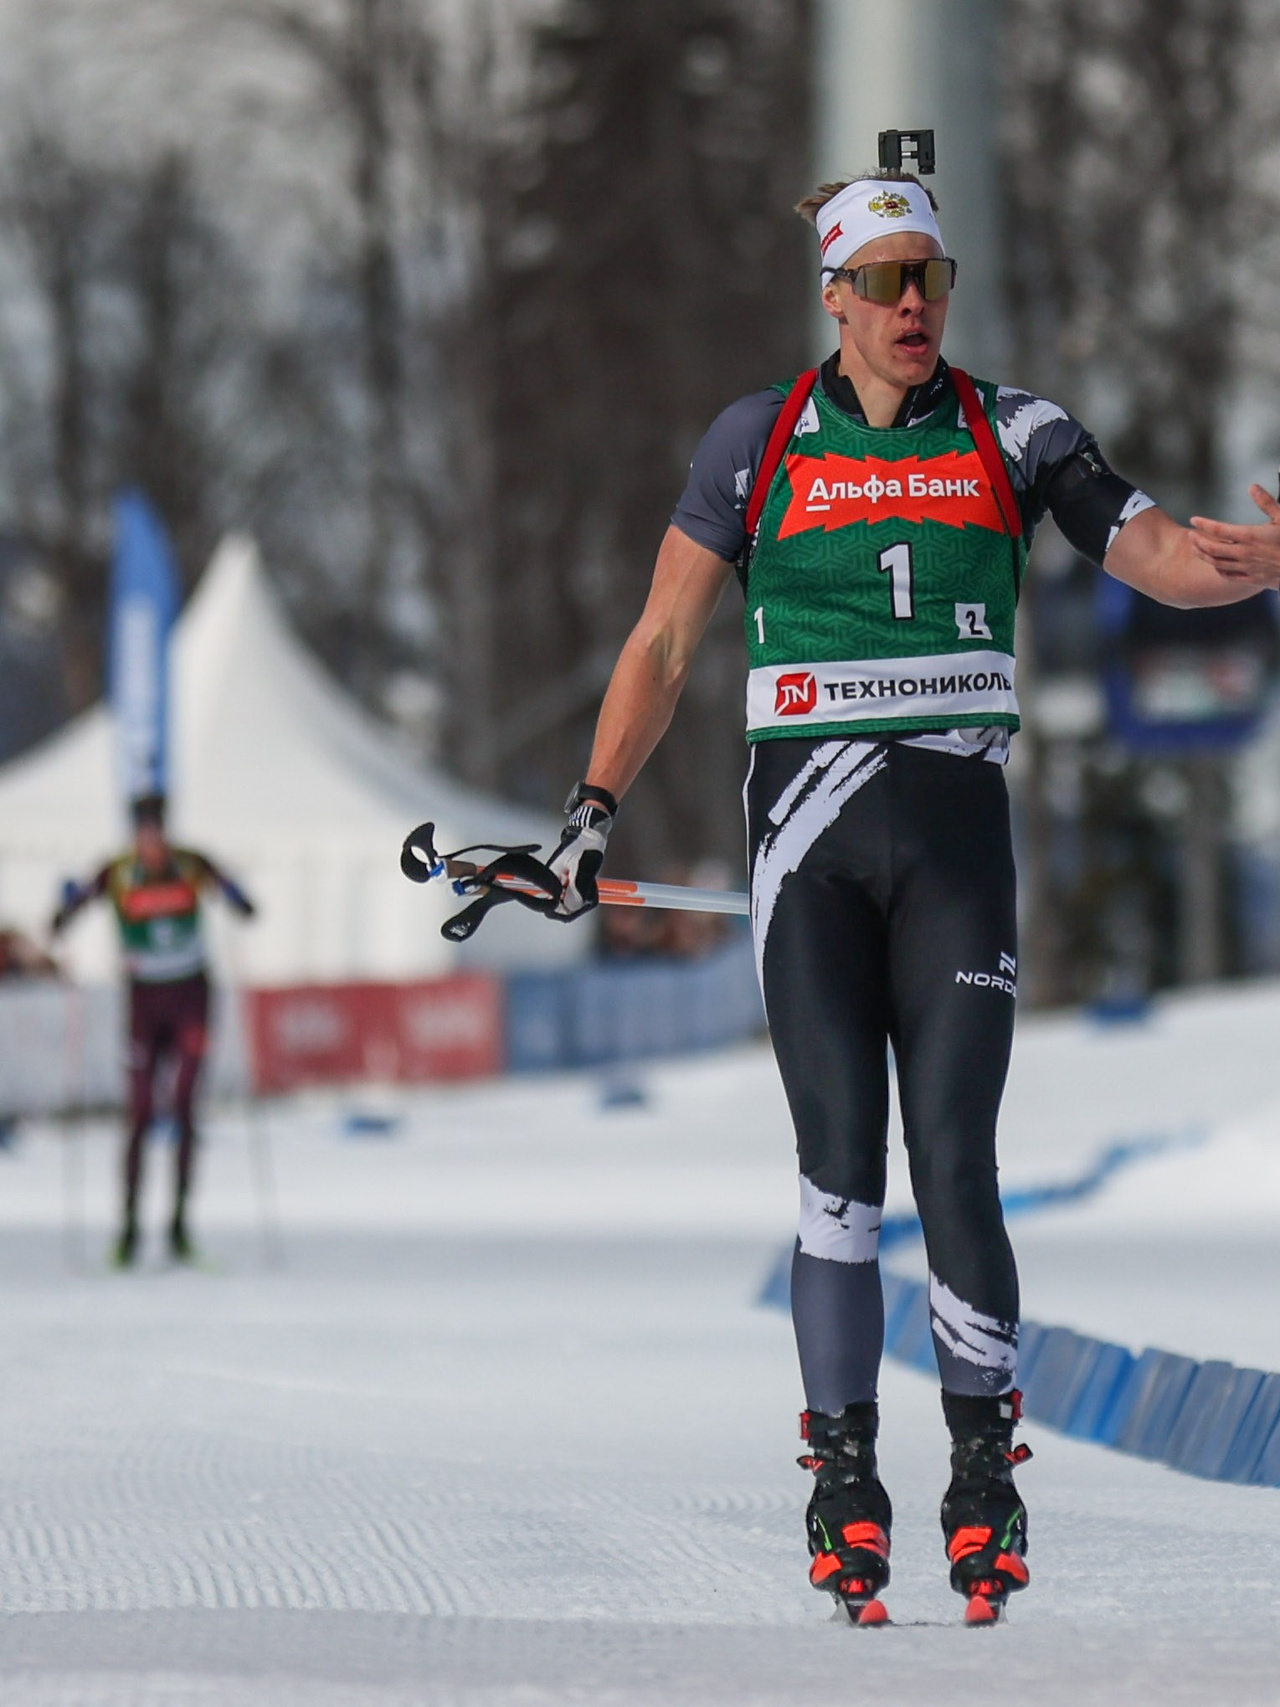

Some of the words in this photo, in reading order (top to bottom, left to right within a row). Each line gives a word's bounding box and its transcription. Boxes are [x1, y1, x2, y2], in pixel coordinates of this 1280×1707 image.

[806, 475, 902, 506] Альфа
[908, 474, 980, 498] Банк
[876, 540, 914, 621] 1
[753, 606, 765, 644] 1
[965, 610, 983, 636] 2
[824, 672, 1012, 701] ТЕХНОНИКОЛЬ
